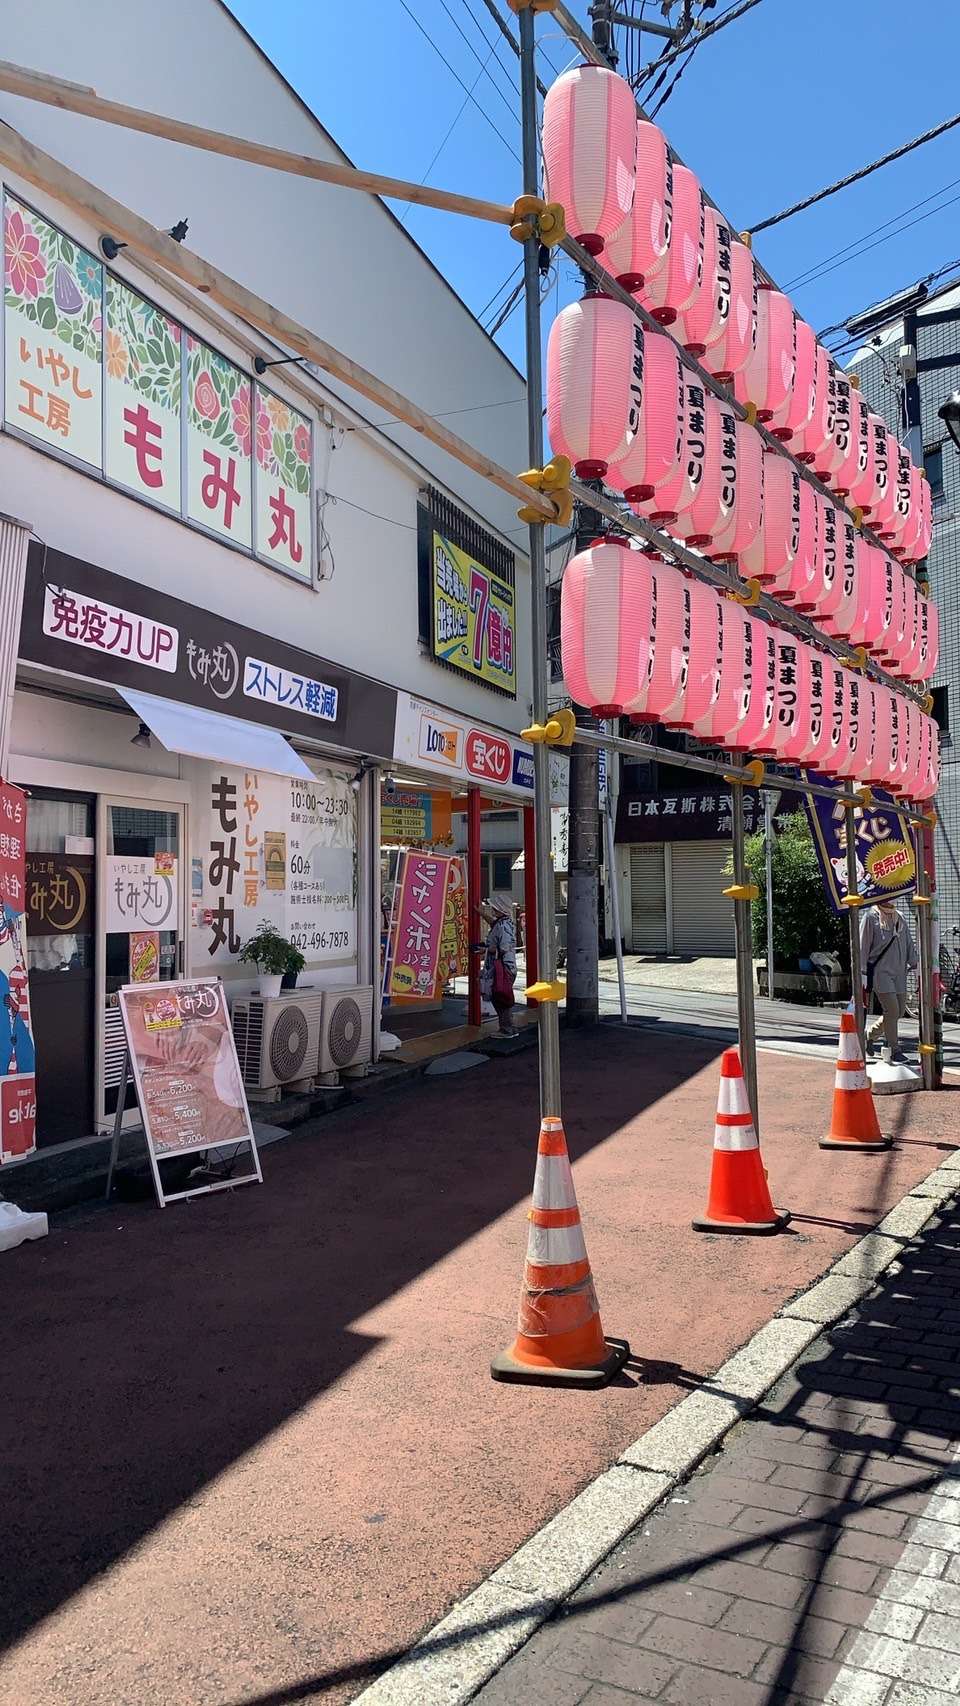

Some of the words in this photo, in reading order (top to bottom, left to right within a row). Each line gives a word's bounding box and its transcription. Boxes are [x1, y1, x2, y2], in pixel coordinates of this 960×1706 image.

[20, 337, 93, 399] いやし
[18, 379, 71, 438] 工房
[687, 384, 706, 485] 夏まつり
[836, 380, 850, 451] 夏まつり
[123, 403, 302, 563] もみ丸
[720, 413, 737, 509] 夏まつり
[873, 424, 888, 489] 夏まつり
[823, 507, 836, 581] 夏まつり
[50, 593, 173, 664] 免疫力UP
[186, 639, 230, 686] もみ丸
[246, 661, 336, 720] ストレス軽減
[778, 645, 797, 727] 夏まつり
[810, 660, 823, 737] 夏まつり
[832, 671, 844, 745] 夏まつり
[849, 682, 859, 752] 夏まつり
[427, 725, 446, 752] LOTO
[472, 738, 506, 775] 宝くじ
[208, 776, 240, 956] もみ丸
[243, 773, 259, 907] いやし工房
[290, 854, 311, 875] 60分
[872, 848, 911, 880] 発売中!
[25, 874, 74, 920] み丸
[114, 875, 163, 918] もみ丸
[290, 931, 349, 951] 042-496-7878
